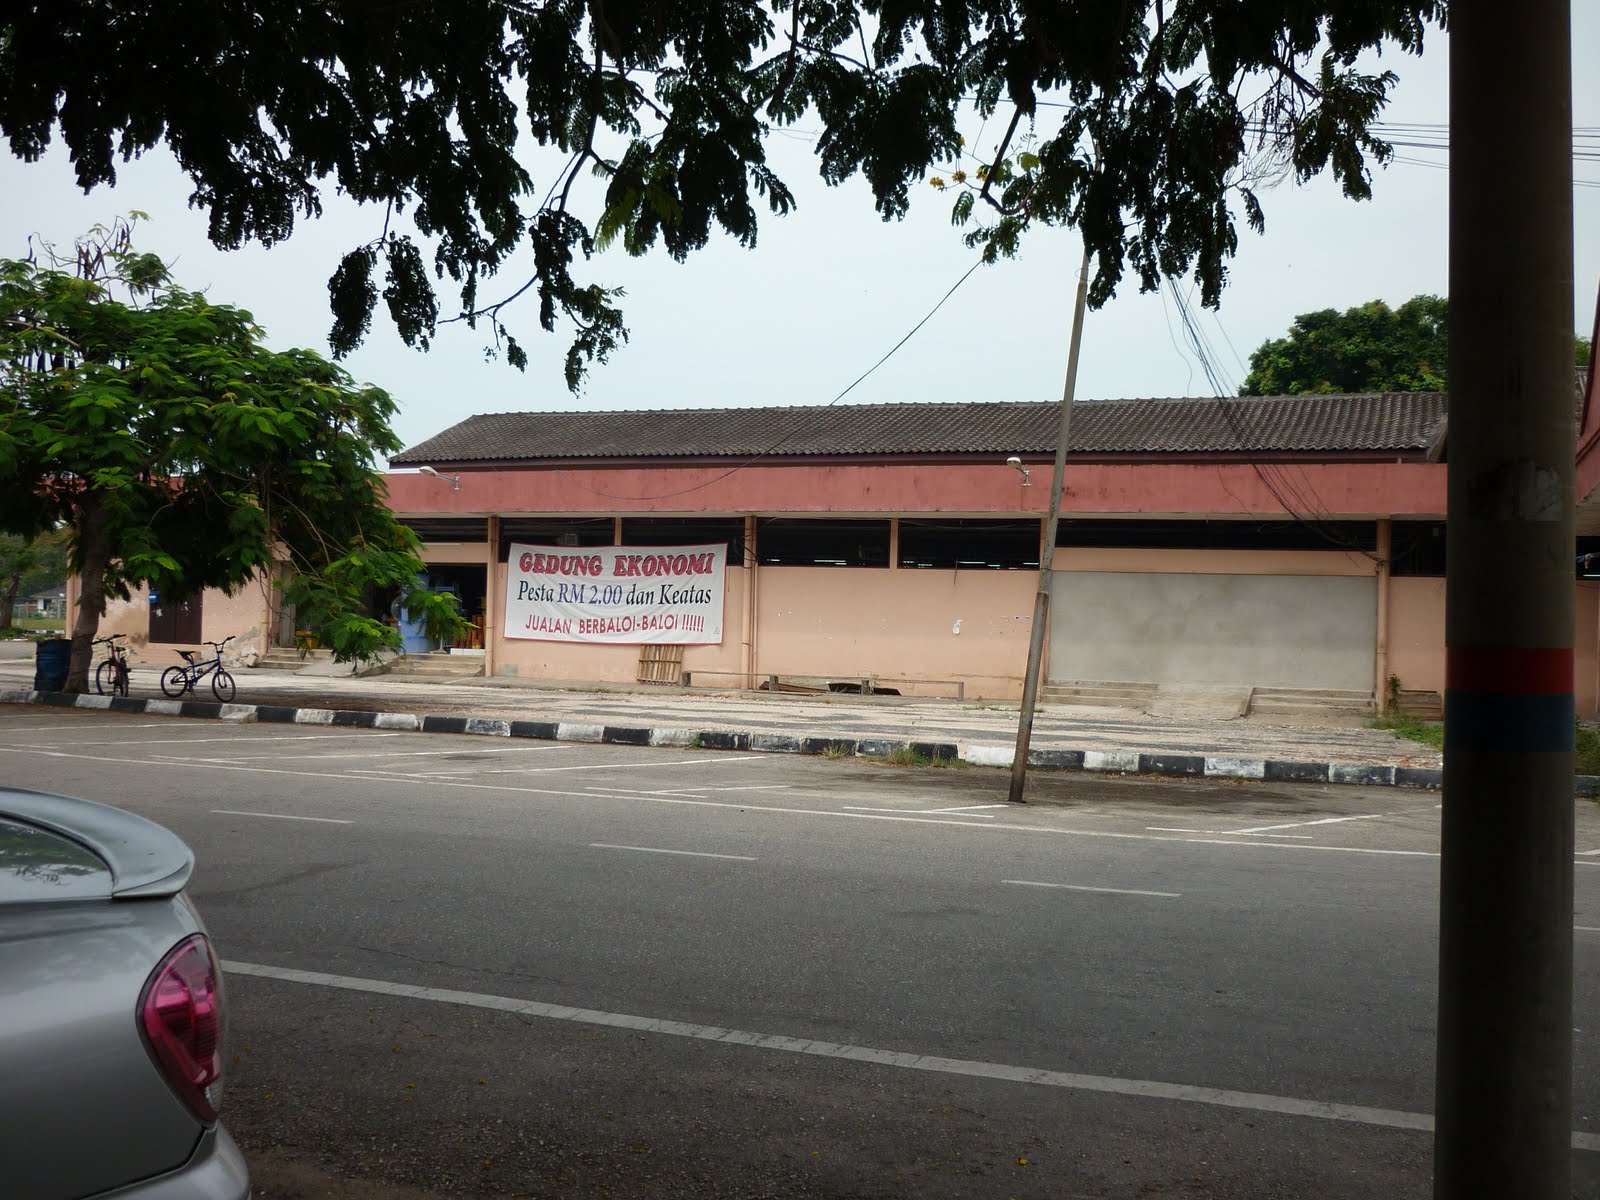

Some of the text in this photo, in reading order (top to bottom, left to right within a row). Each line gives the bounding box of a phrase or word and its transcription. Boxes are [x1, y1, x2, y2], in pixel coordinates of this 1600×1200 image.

[519, 552, 715, 577] GEDUNG EKONOMI
[517, 580, 712, 606] Pesta RM 2.00 dan Keatas
[525, 614, 572, 634] JUALAN
[579, 614, 678, 634] BERBALOI-BALOI
